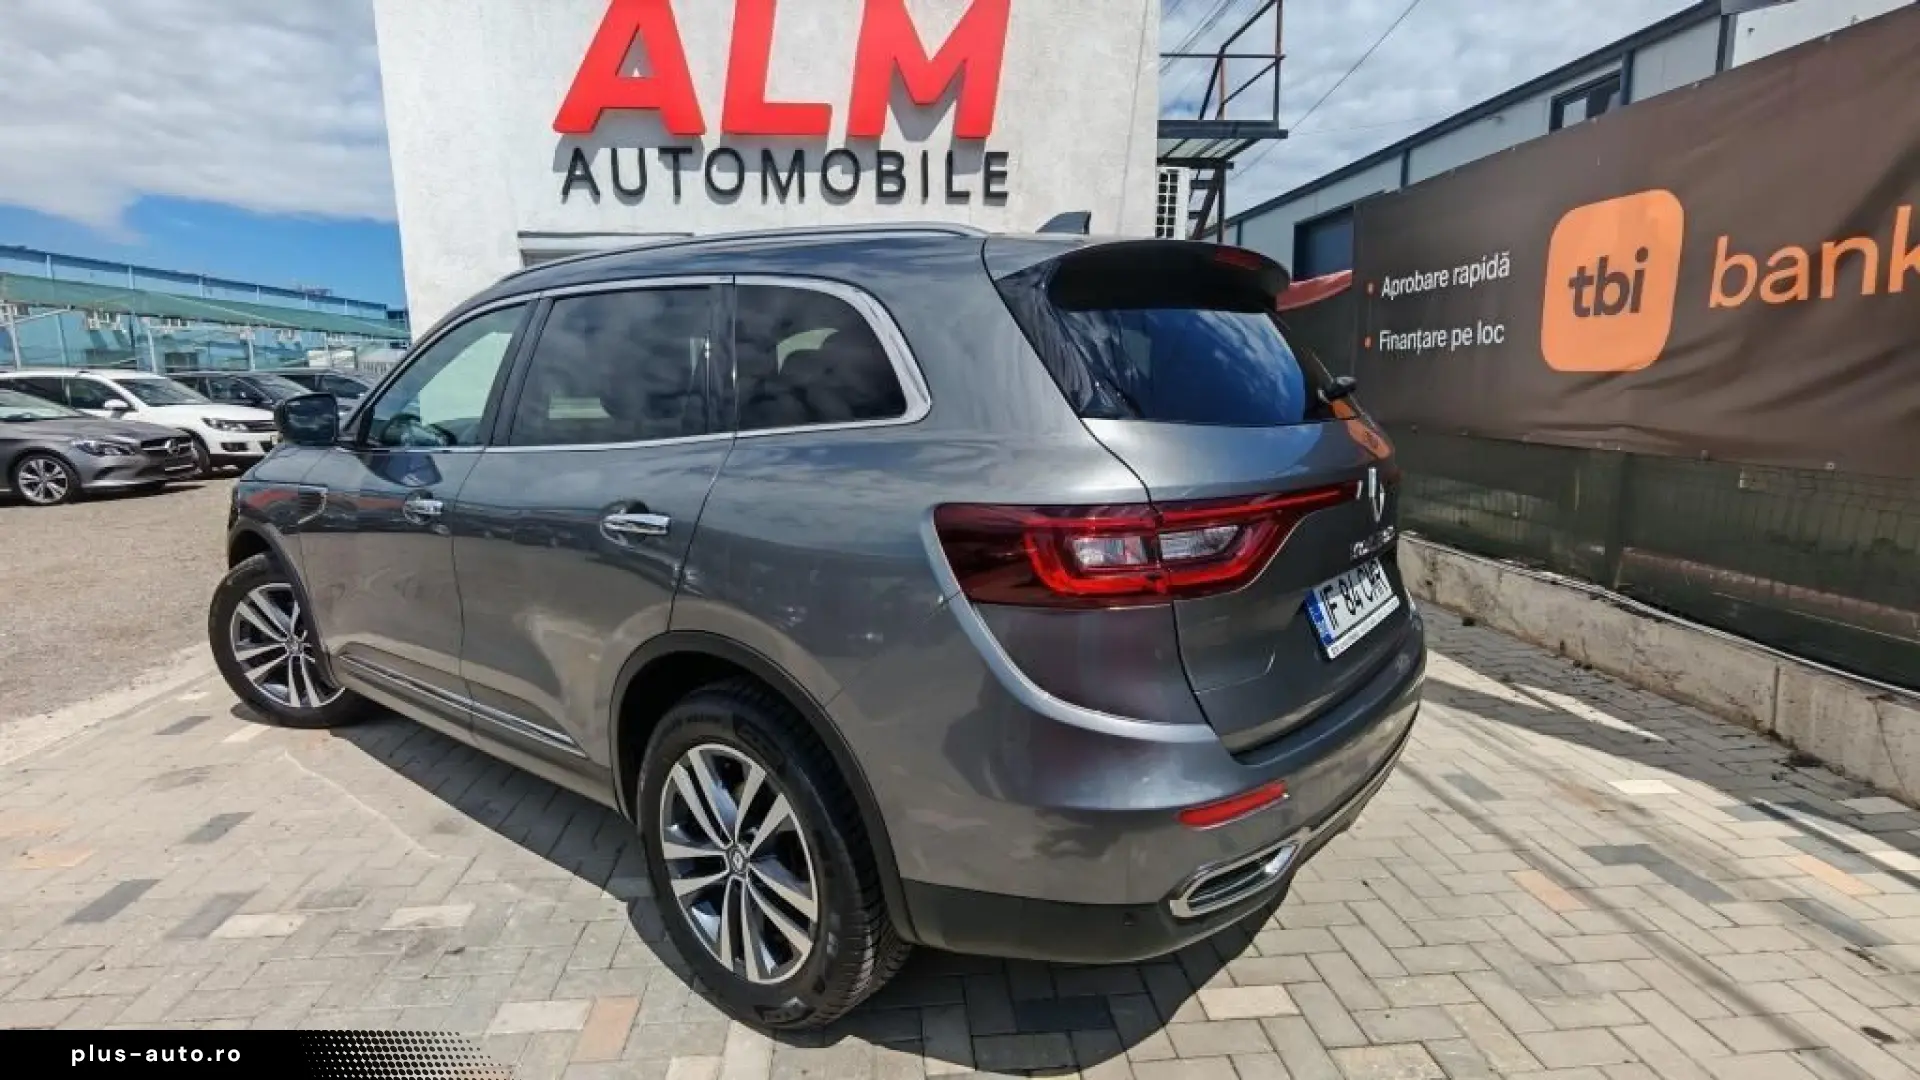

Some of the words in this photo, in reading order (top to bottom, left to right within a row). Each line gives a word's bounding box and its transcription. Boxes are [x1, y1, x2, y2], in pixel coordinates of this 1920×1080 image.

[552, 0, 1011, 138] ALM
[562, 147, 1009, 205] AUTOMOBILE
[1381, 269, 1449, 301] Aprobare
[1453, 251, 1511, 289] rapidă
[1568, 246, 1649, 318] tbi
[1379, 328, 1448, 356] Finanțare
[1451, 327, 1473, 352] pe
[1477, 319, 1505, 346] loc
